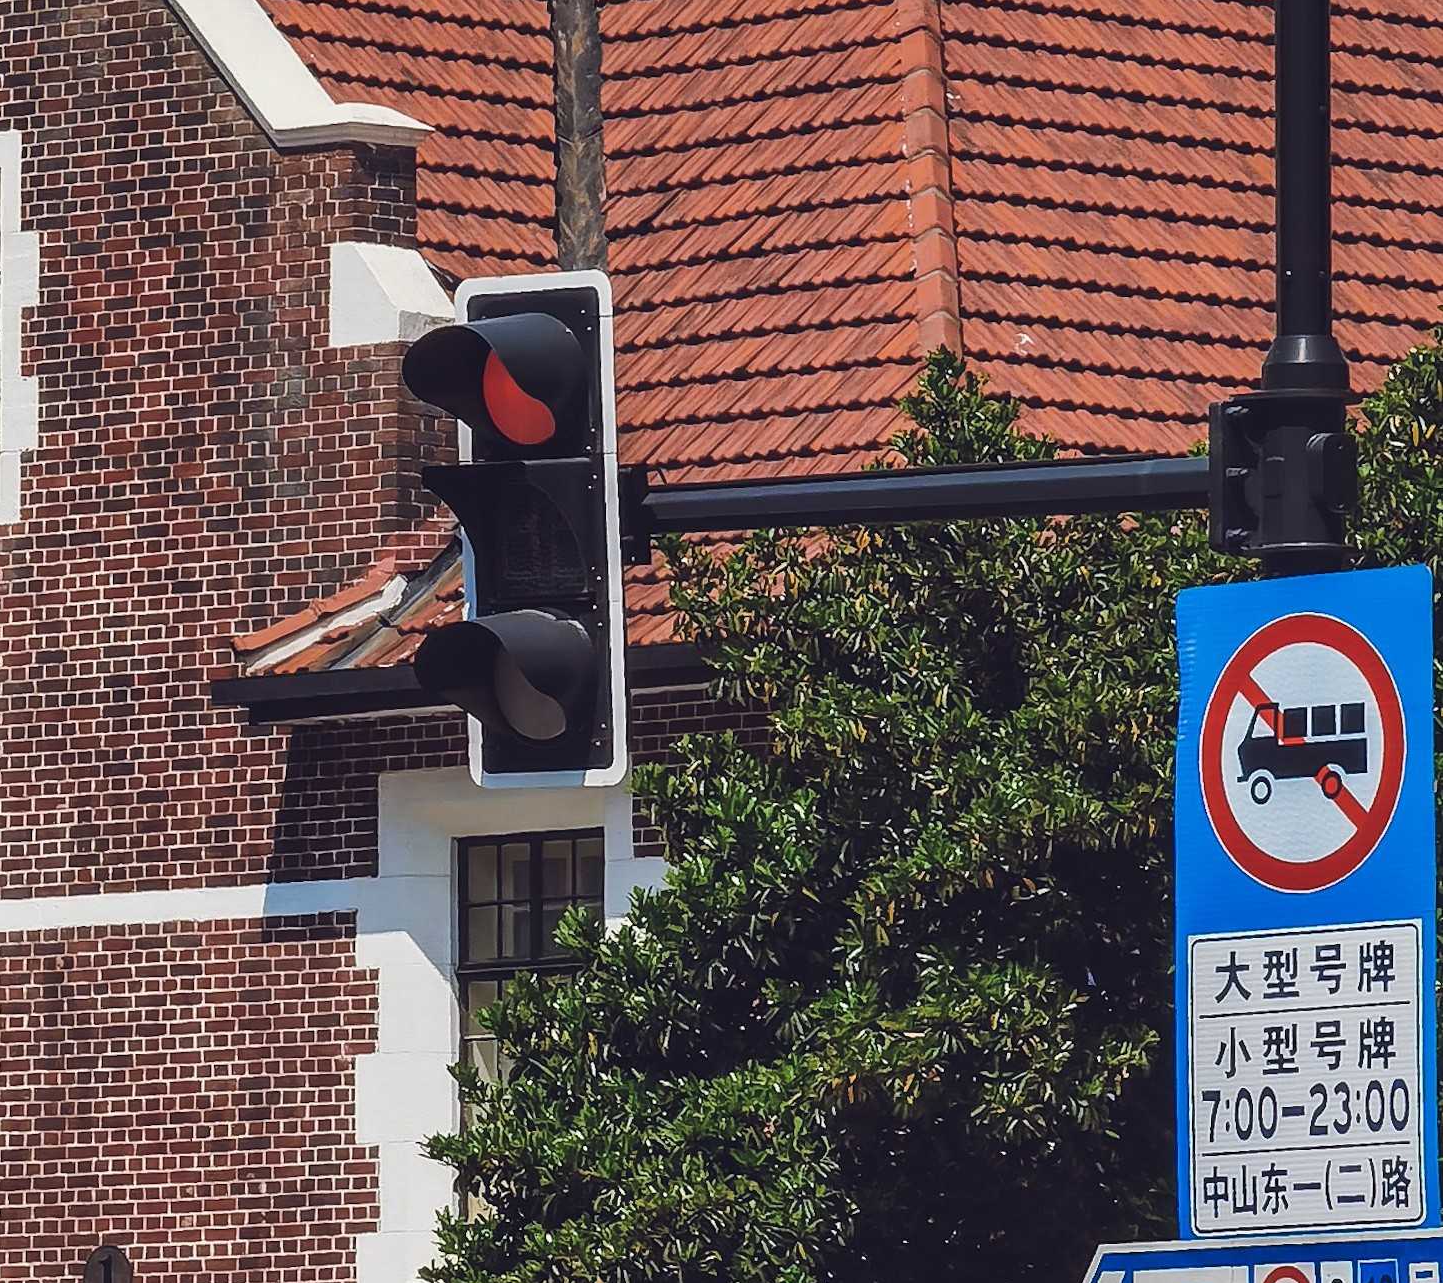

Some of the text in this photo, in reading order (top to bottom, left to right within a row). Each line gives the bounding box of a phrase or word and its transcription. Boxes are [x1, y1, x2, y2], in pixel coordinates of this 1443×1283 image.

[1214, 940, 1397, 1004] 大型号牌
[1214, 1016, 1397, 1079] 小型号牌
[1202, 1078, 1410, 1144] 7:00-23:00
[1202, 1155, 1412, 1218] 中山东一(二)路
